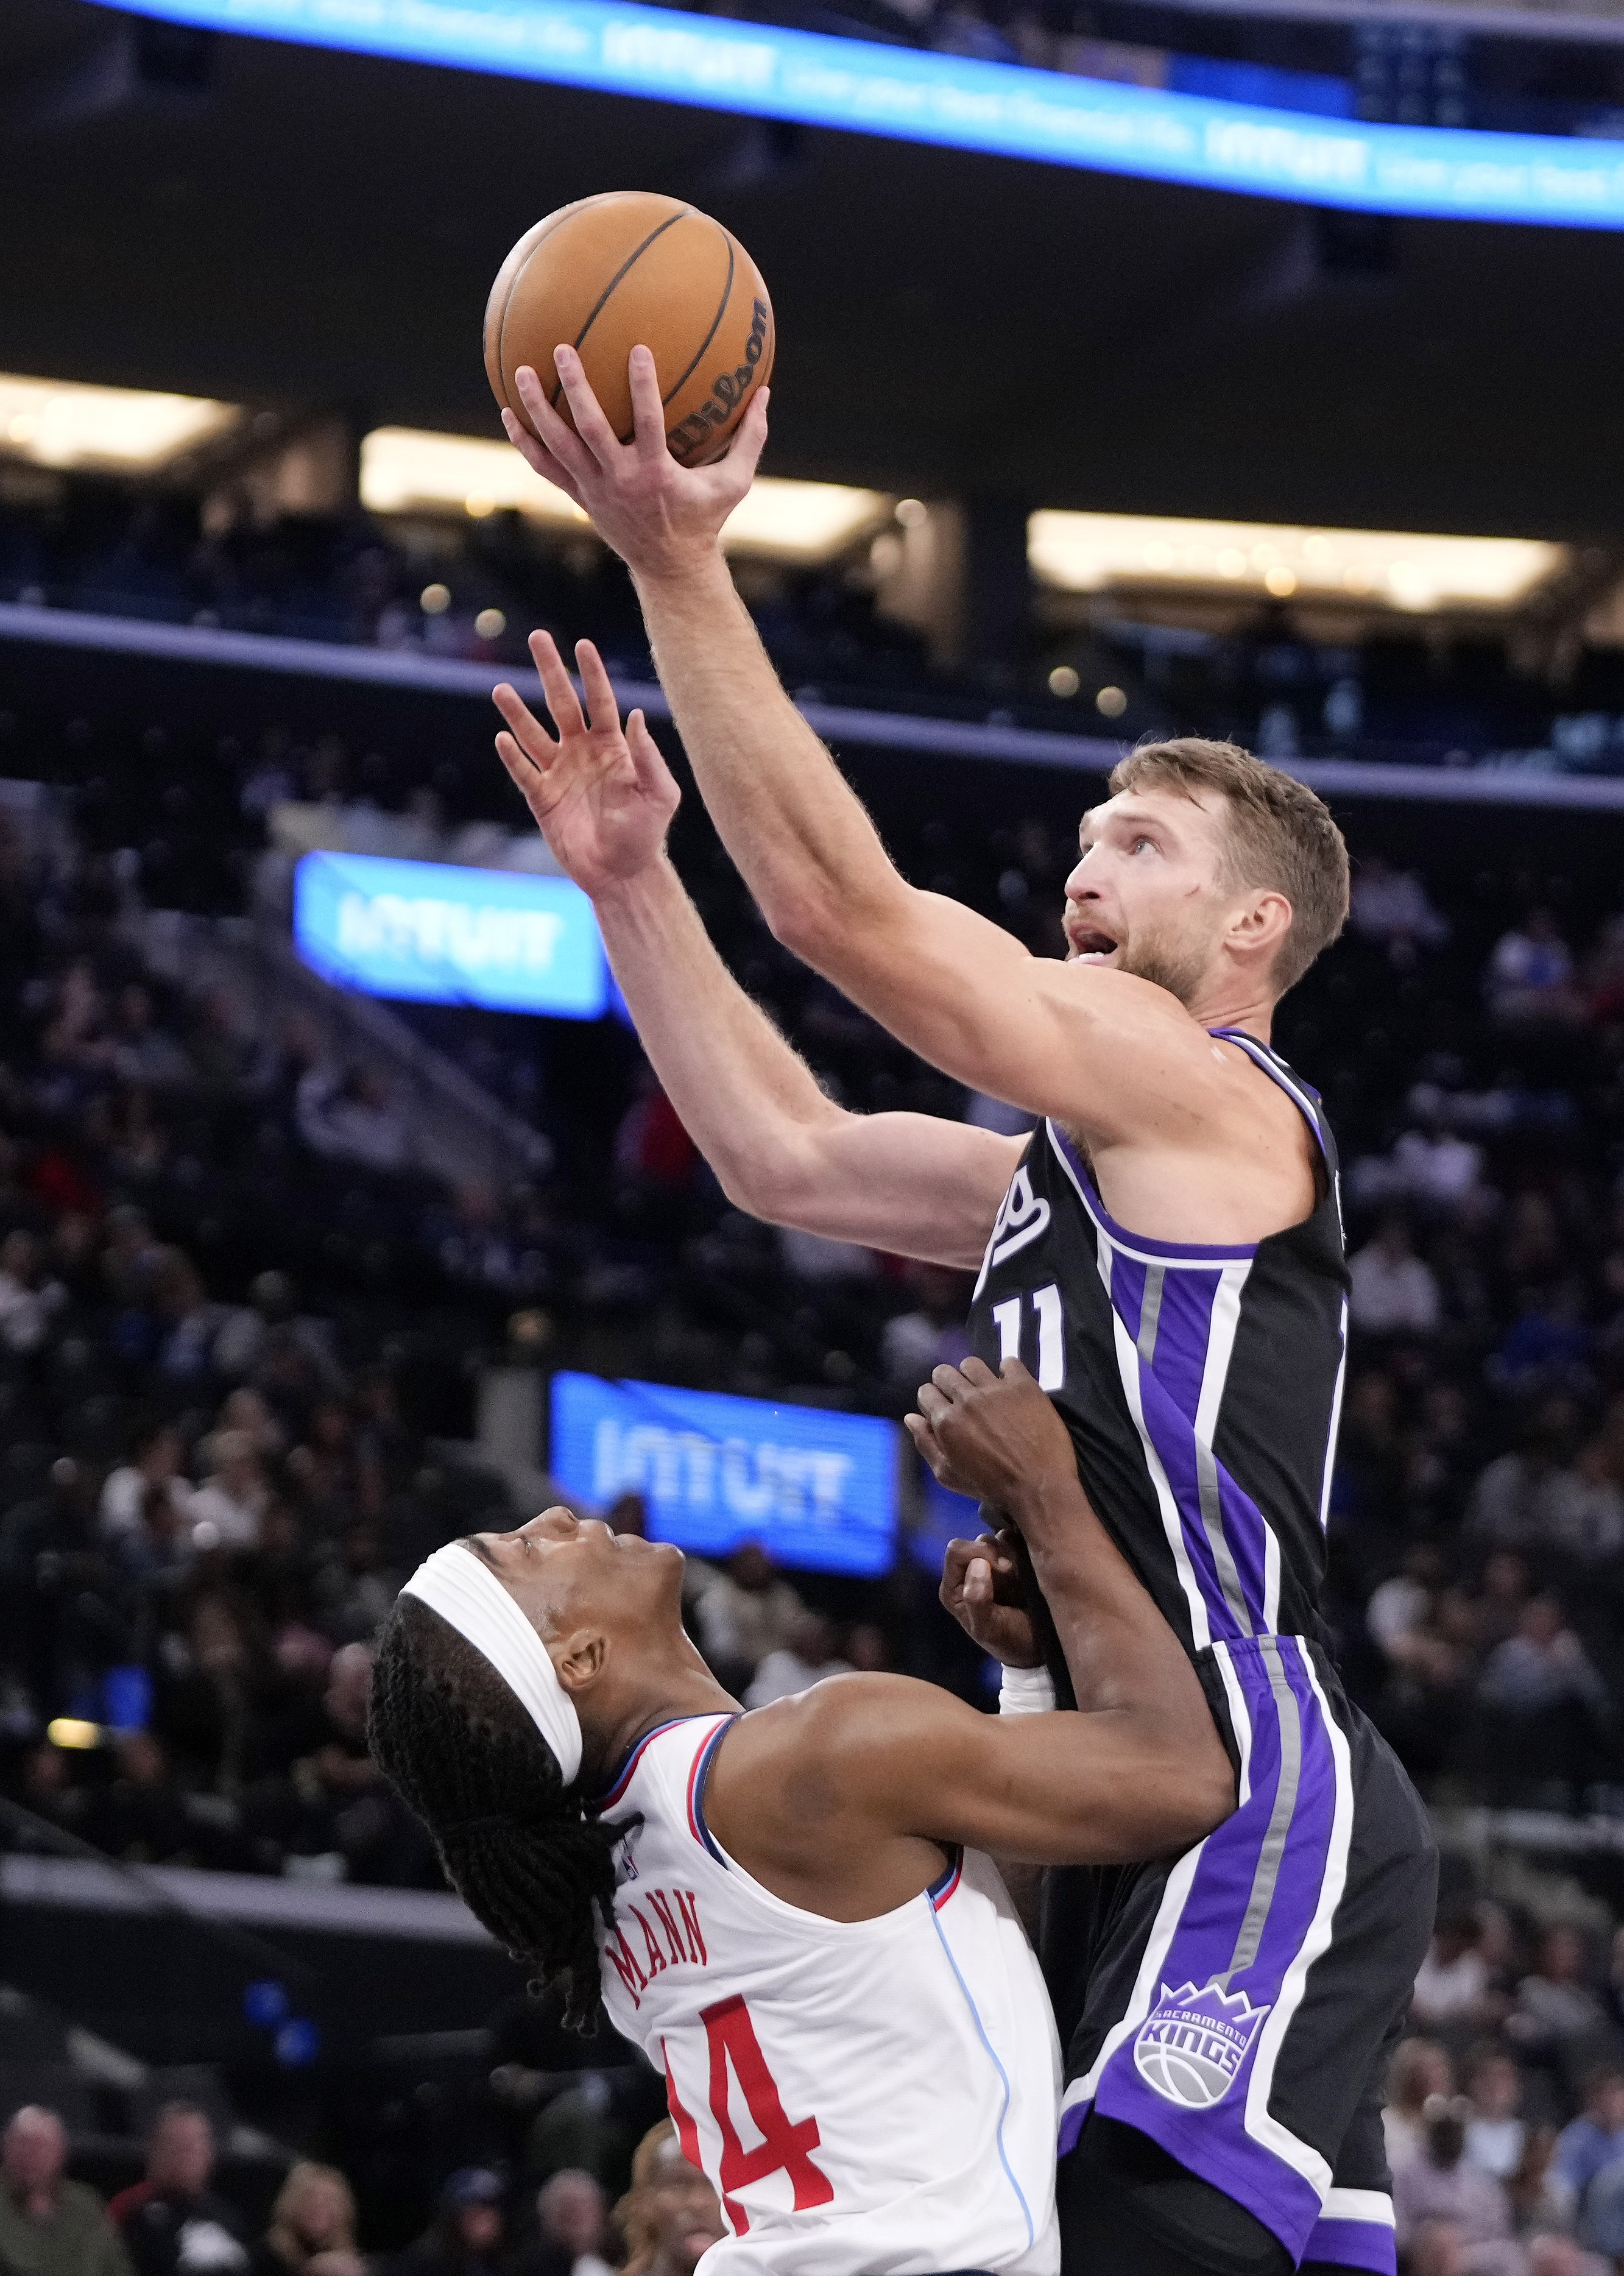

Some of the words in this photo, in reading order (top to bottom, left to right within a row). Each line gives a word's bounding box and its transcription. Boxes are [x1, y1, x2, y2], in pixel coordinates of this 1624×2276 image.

[665, 297, 767, 458] Wilson
[993, 1283, 1064, 1391] 11
[605, 1889, 707, 2010] MANN
[1140, 2021, 1243, 2077] KINGS
[1155, 2010, 1248, 2048] SACRAMENTO
